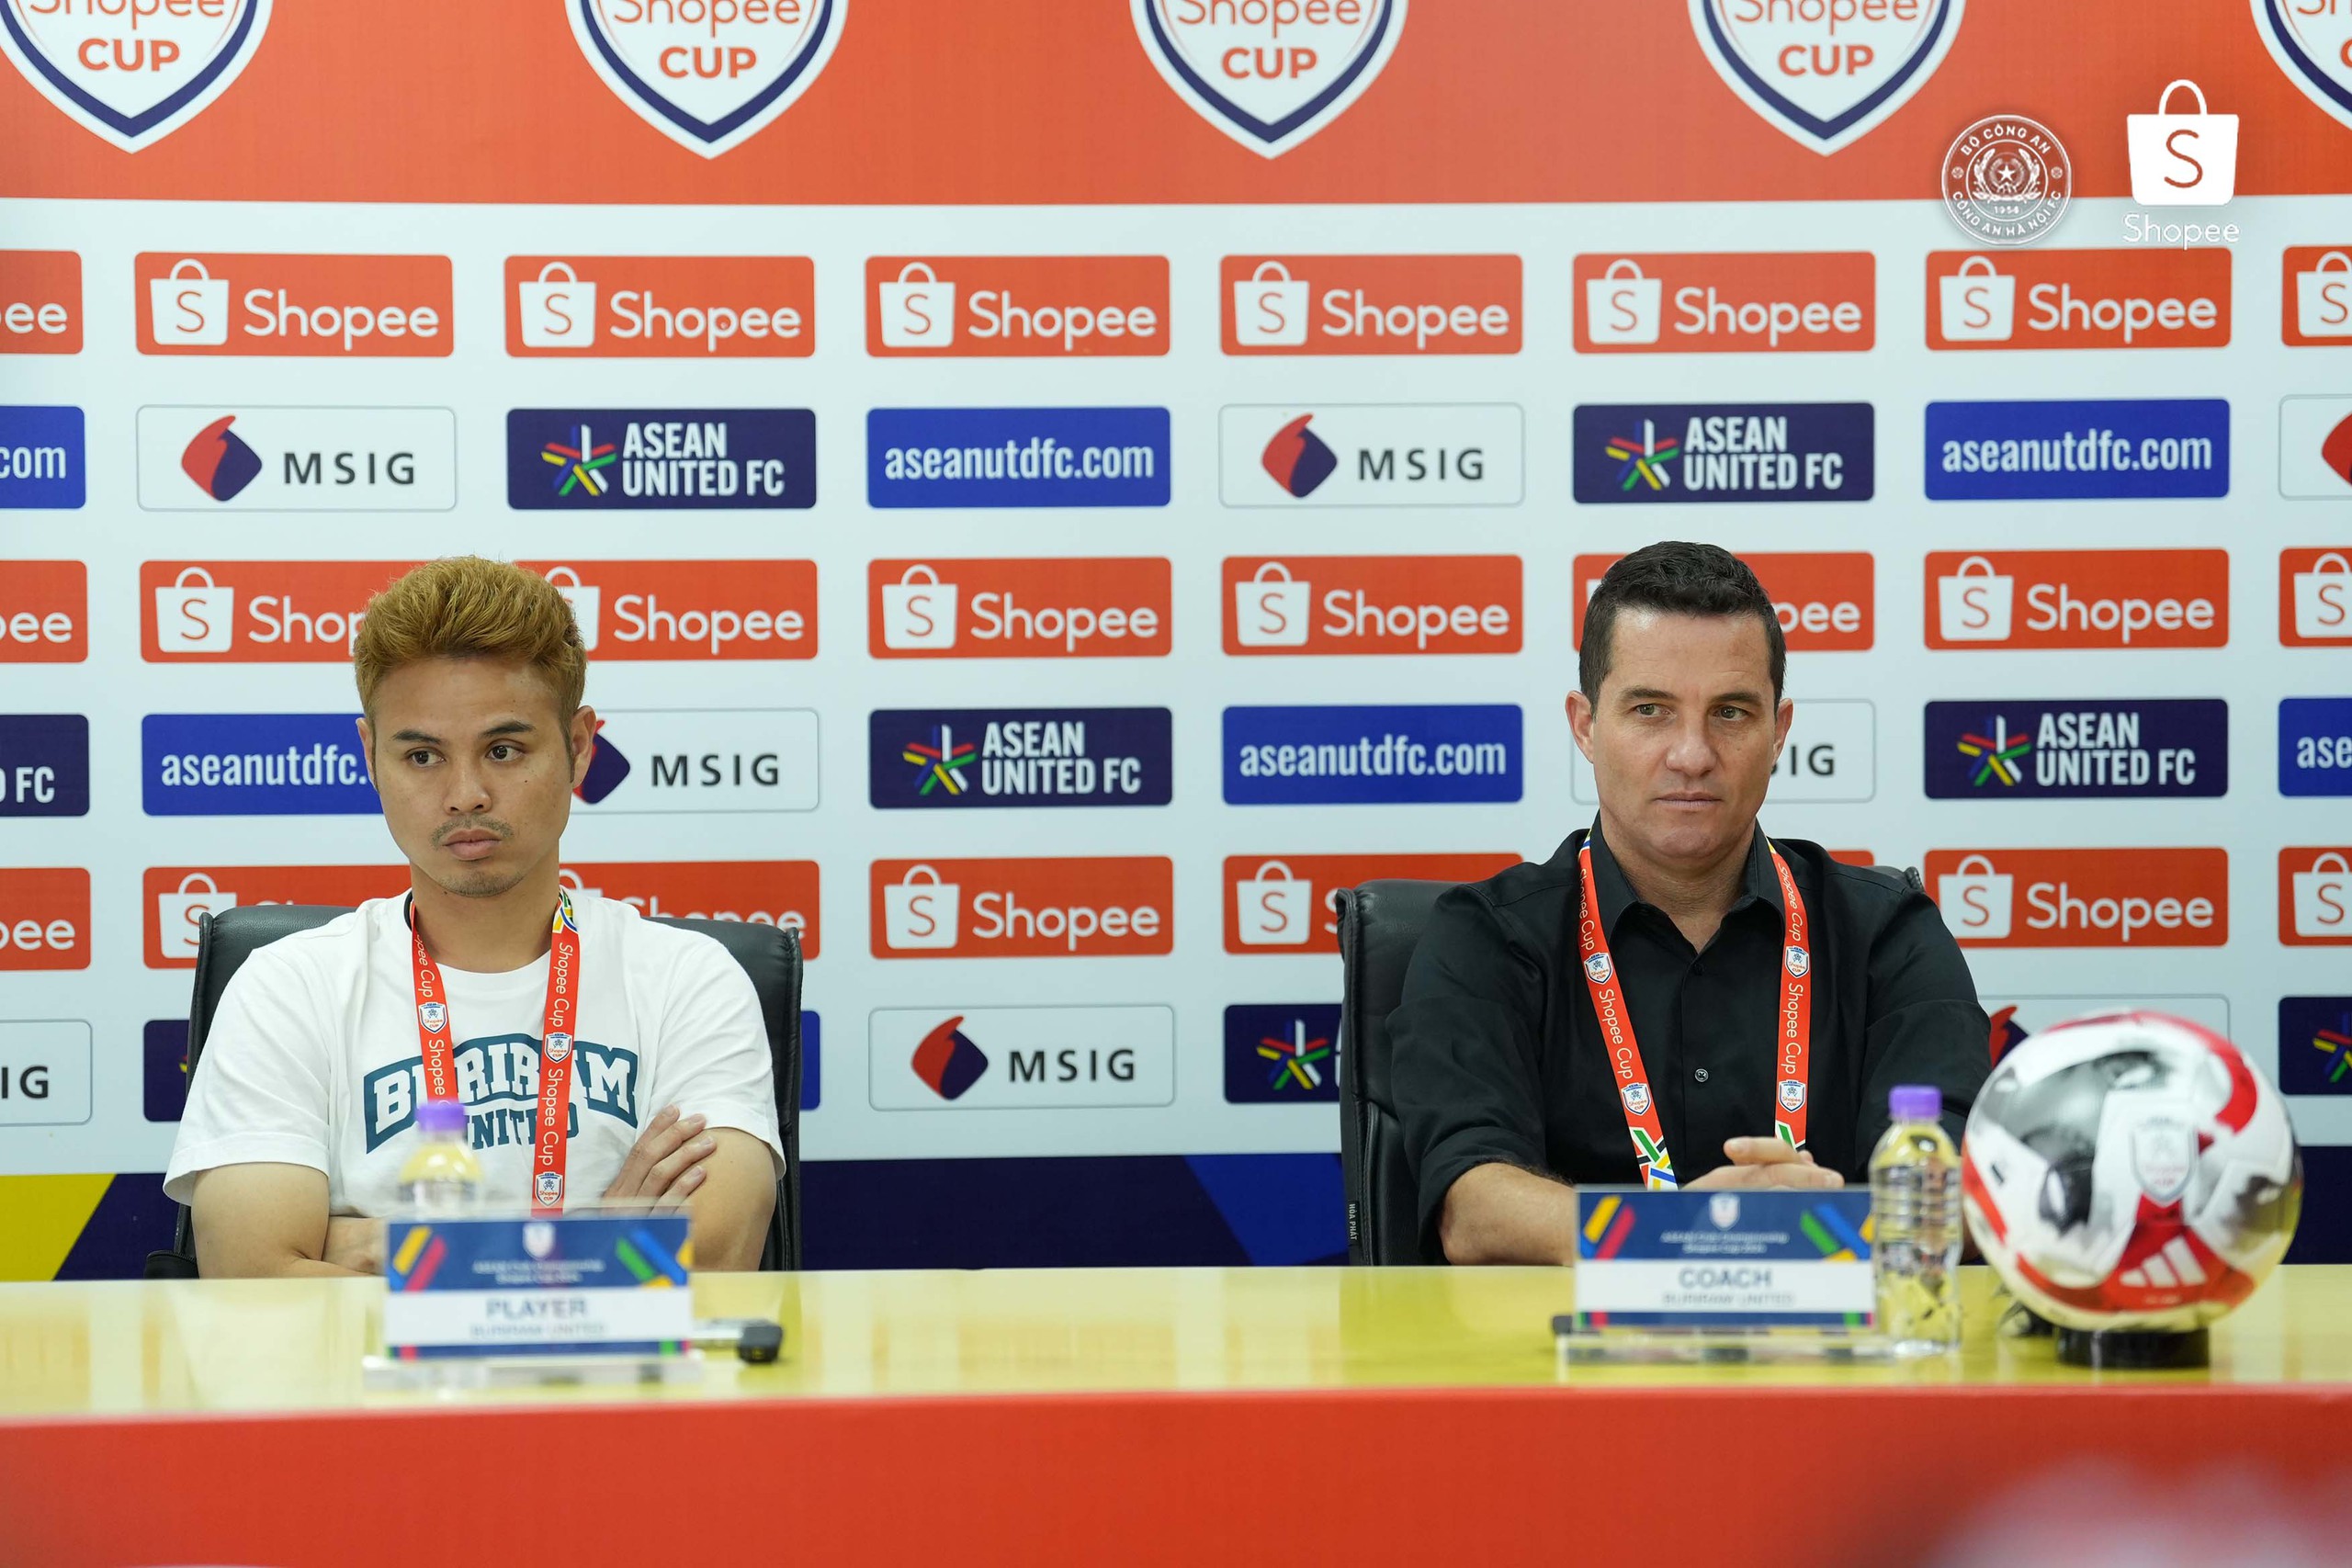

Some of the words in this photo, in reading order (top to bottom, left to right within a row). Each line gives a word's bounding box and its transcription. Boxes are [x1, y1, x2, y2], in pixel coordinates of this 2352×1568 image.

[77, 38, 180, 72] CUP
[659, 46, 757, 79] CUP
[1221, 47, 1317, 80] CUP
[1778, 44, 1875, 77] CUP
[0, 302, 68, 334] ee
[243, 288, 439, 351] Shopee
[610, 290, 802, 353] Shopee
[968, 289, 1158, 352] Shopee
[1322, 288, 1510, 350] Shopee
[1674, 286, 1862, 347] Shopee
[2028, 283, 2218, 344] Shopee
[623, 422, 727, 459] ASEAN
[1684, 416, 1787, 453] ASEAN
[1941, 428, 2211, 473] aseanutdfc.com
[284, 452, 414, 486] MSIG
[885, 436, 1154, 479] aseanutdfc.com
[1359, 447, 1483, 481] MSIG
[1683, 454, 1798, 490] UNITED
[1804, 453, 1844, 489] FC
[622, 461, 737, 497] UNITED
[746, 459, 786, 496] FC
[0, 612, 73, 643] ee
[248, 595, 367, 657] Shop
[614, 593, 804, 655] Shopee
[970, 592, 1159, 652] Shopee
[1323, 589, 1510, 649] Shopee
[2026, 582, 2215, 644] Shopee
[982, 721, 1084, 758] ASEAN
[2037, 712, 2139, 749] ASEAN
[651, 753, 779, 787] MSIG
[1239, 733, 1506, 777] aseanutdfc.com
[1770, 744, 1835, 777] IG
[2036, 750, 2152, 786] UNITED
[2157, 749, 2196, 785] FC
[16, 766, 55, 804] FC
[981, 759, 1092, 795] UNITED
[1102, 758, 1141, 794] FC
[972, 891, 1159, 952] Shopee
[1788, 912, 1804, 942] Cup
[2027, 882, 2214, 942] Shopee
[1580, 919, 1596, 951] Cup
[417, 969, 435, 998] Cup
[553, 942, 574, 995] Shopee
[548, 998, 570, 1028] Cup
[1782, 982, 1804, 1038] Shopee
[1599, 988, 1623, 1044] Shopee
[1616, 1047, 1634, 1079] Cup
[427, 1039, 446, 1096] Shopee
[1009, 1048, 1135, 1083] MSIG
[1781, 1042, 1802, 1075] Cup
[540, 1068, 564, 1127] Shopee
[537, 1131, 559, 1167] Cup
[1679, 1269, 1771, 1289] COACH
[486, 1297, 587, 1319] PLAYER
